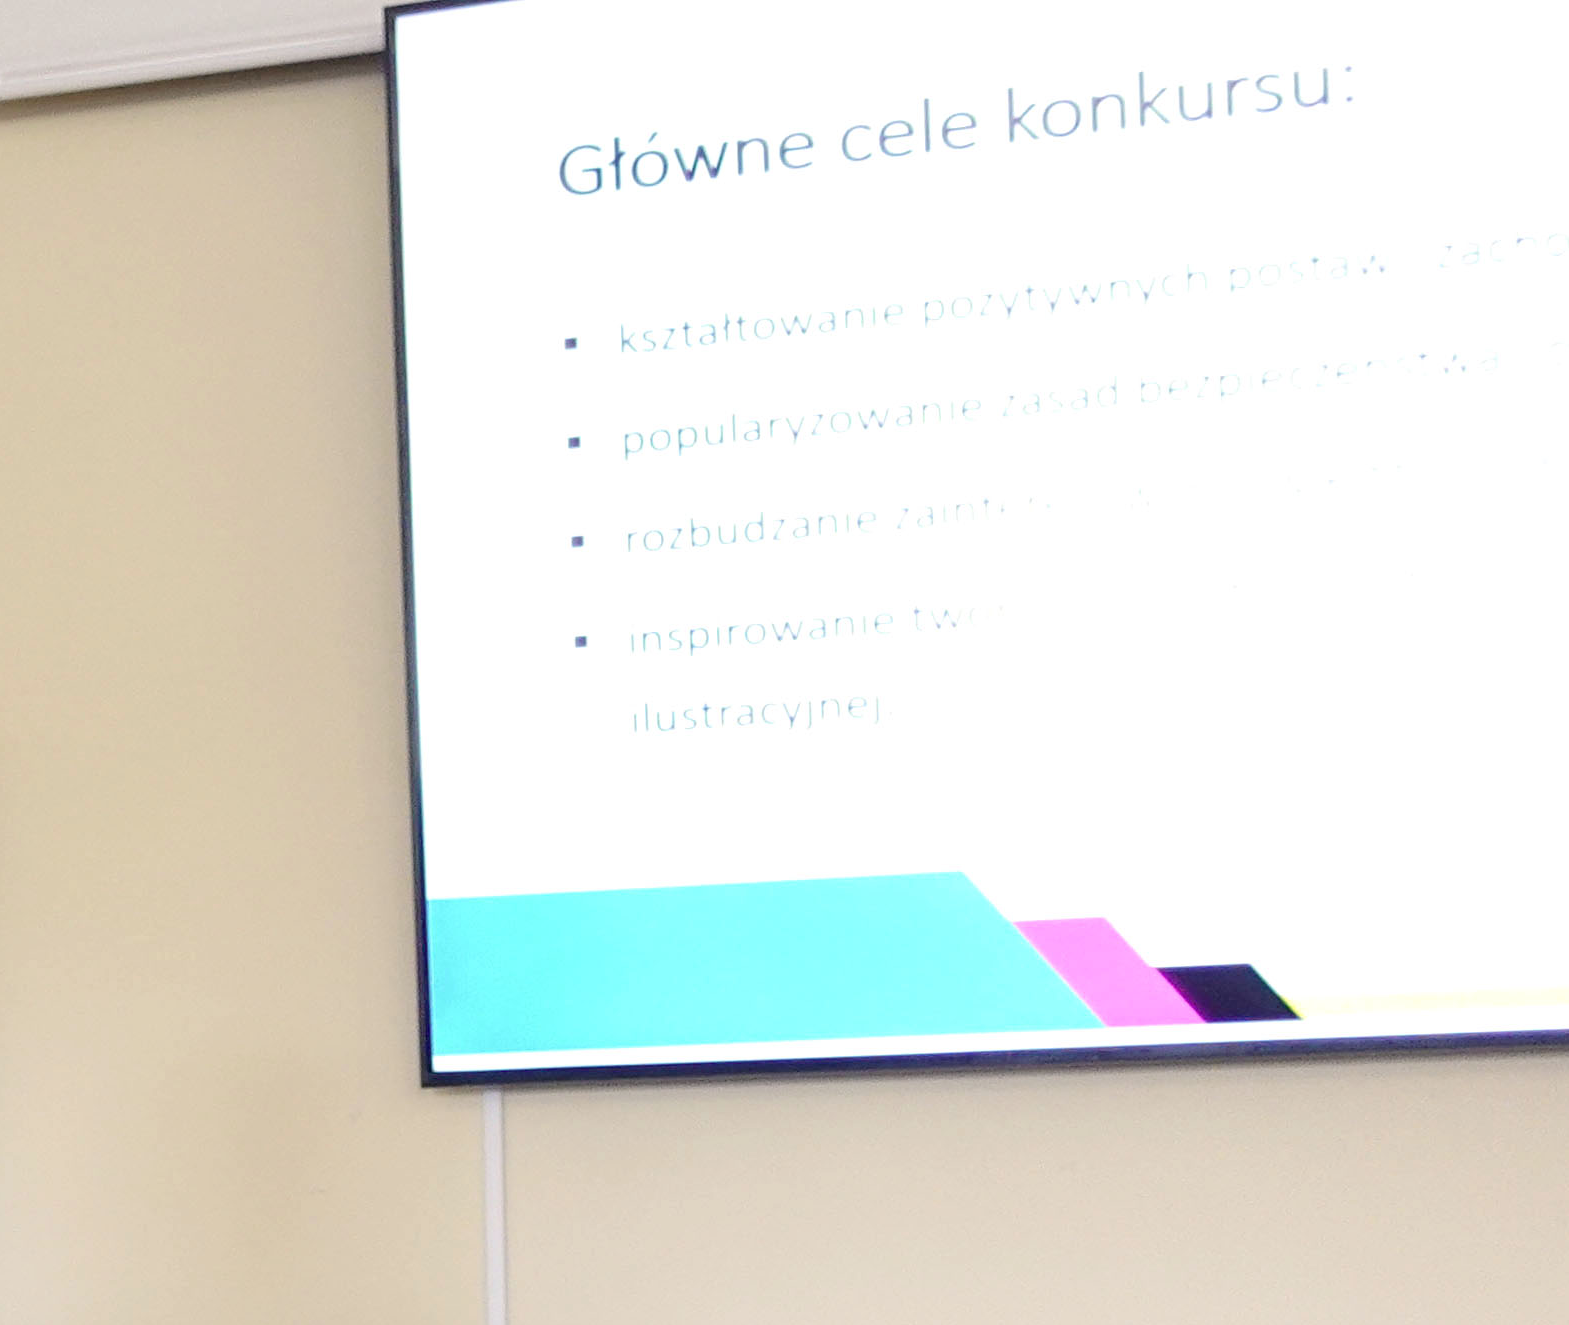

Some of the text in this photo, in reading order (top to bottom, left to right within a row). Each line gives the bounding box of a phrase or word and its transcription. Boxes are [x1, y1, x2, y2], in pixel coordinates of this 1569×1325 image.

[558, 66, 1354, 196] Główne cele konkursu:
[619, 303, 903, 352] kształtowanie
[924, 263, 1210, 325] pozytywnych
[623, 399, 982, 462] popularyzowanie
[626, 508, 877, 552] rozbudzanie
[629, 610, 894, 656] inspirowanie
